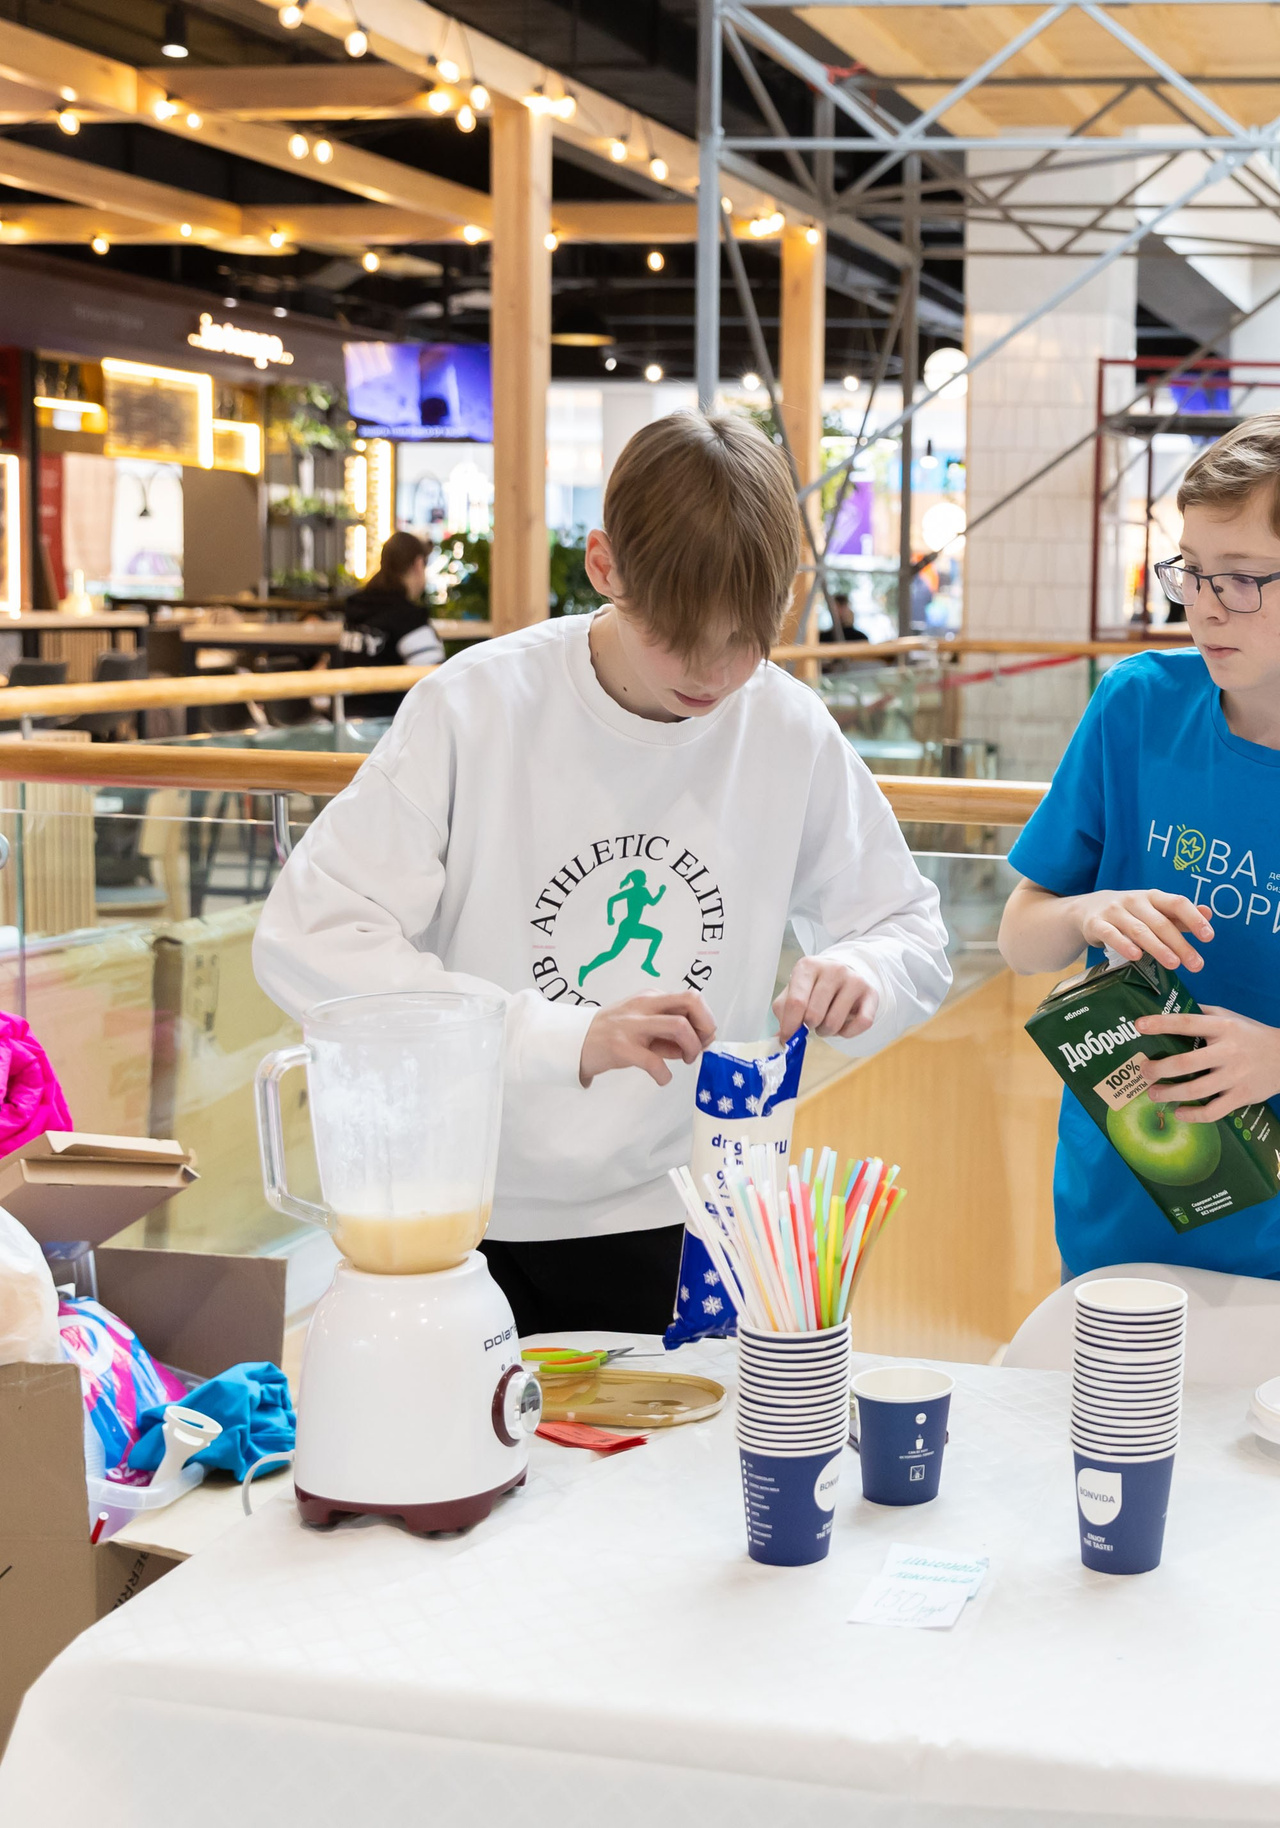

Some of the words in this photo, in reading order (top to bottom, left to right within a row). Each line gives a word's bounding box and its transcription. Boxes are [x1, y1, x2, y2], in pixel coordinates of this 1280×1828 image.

[530, 834, 670, 937] ATHLETIC
[669, 848, 725, 943] ELITE
[532, 955, 602, 1007] LUB
[1064, 1006, 1090, 1021] яблоко
[1057, 1016, 1142, 1073] Добрый
[1105, 1060, 1141, 1090] 100%
[1113, 1073, 1144, 1099] НАТУРАЛЬН
[1125, 1081, 1148, 1099] ФРУКТЫ
[1079, 1486, 1116, 1504] BONVIDA
[1083, 1537, 1093, 1547] THE
[1092, 1541, 1114, 1552] TASTE!
[1087, 1532, 1106, 1543] ENJOY
